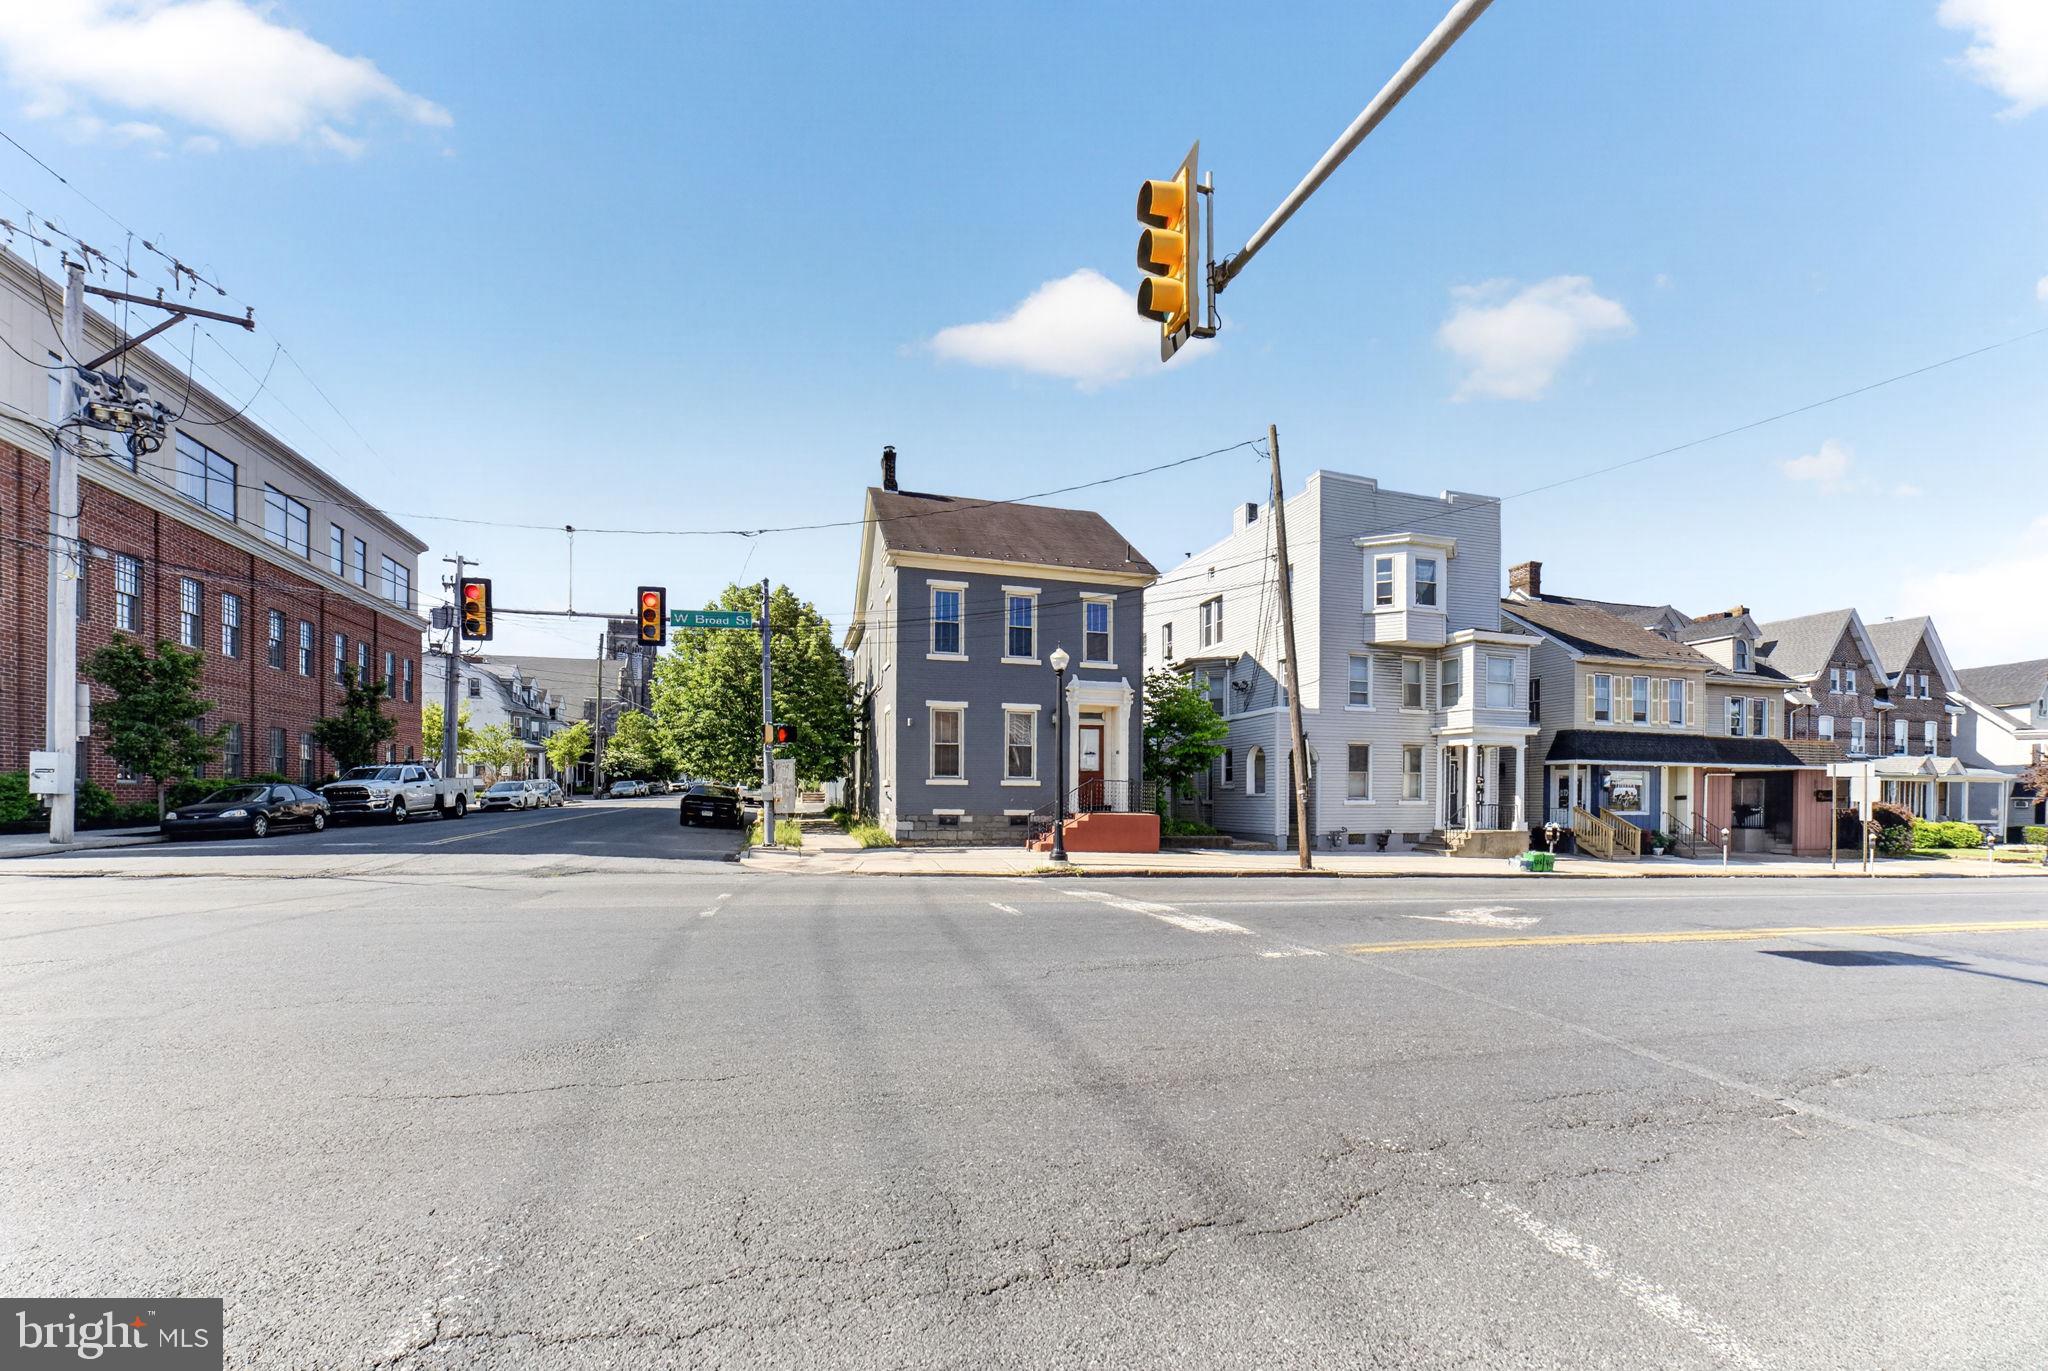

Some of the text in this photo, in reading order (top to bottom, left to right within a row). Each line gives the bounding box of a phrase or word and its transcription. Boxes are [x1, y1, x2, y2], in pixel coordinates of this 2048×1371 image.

[674, 614, 749, 626] W Broad St
